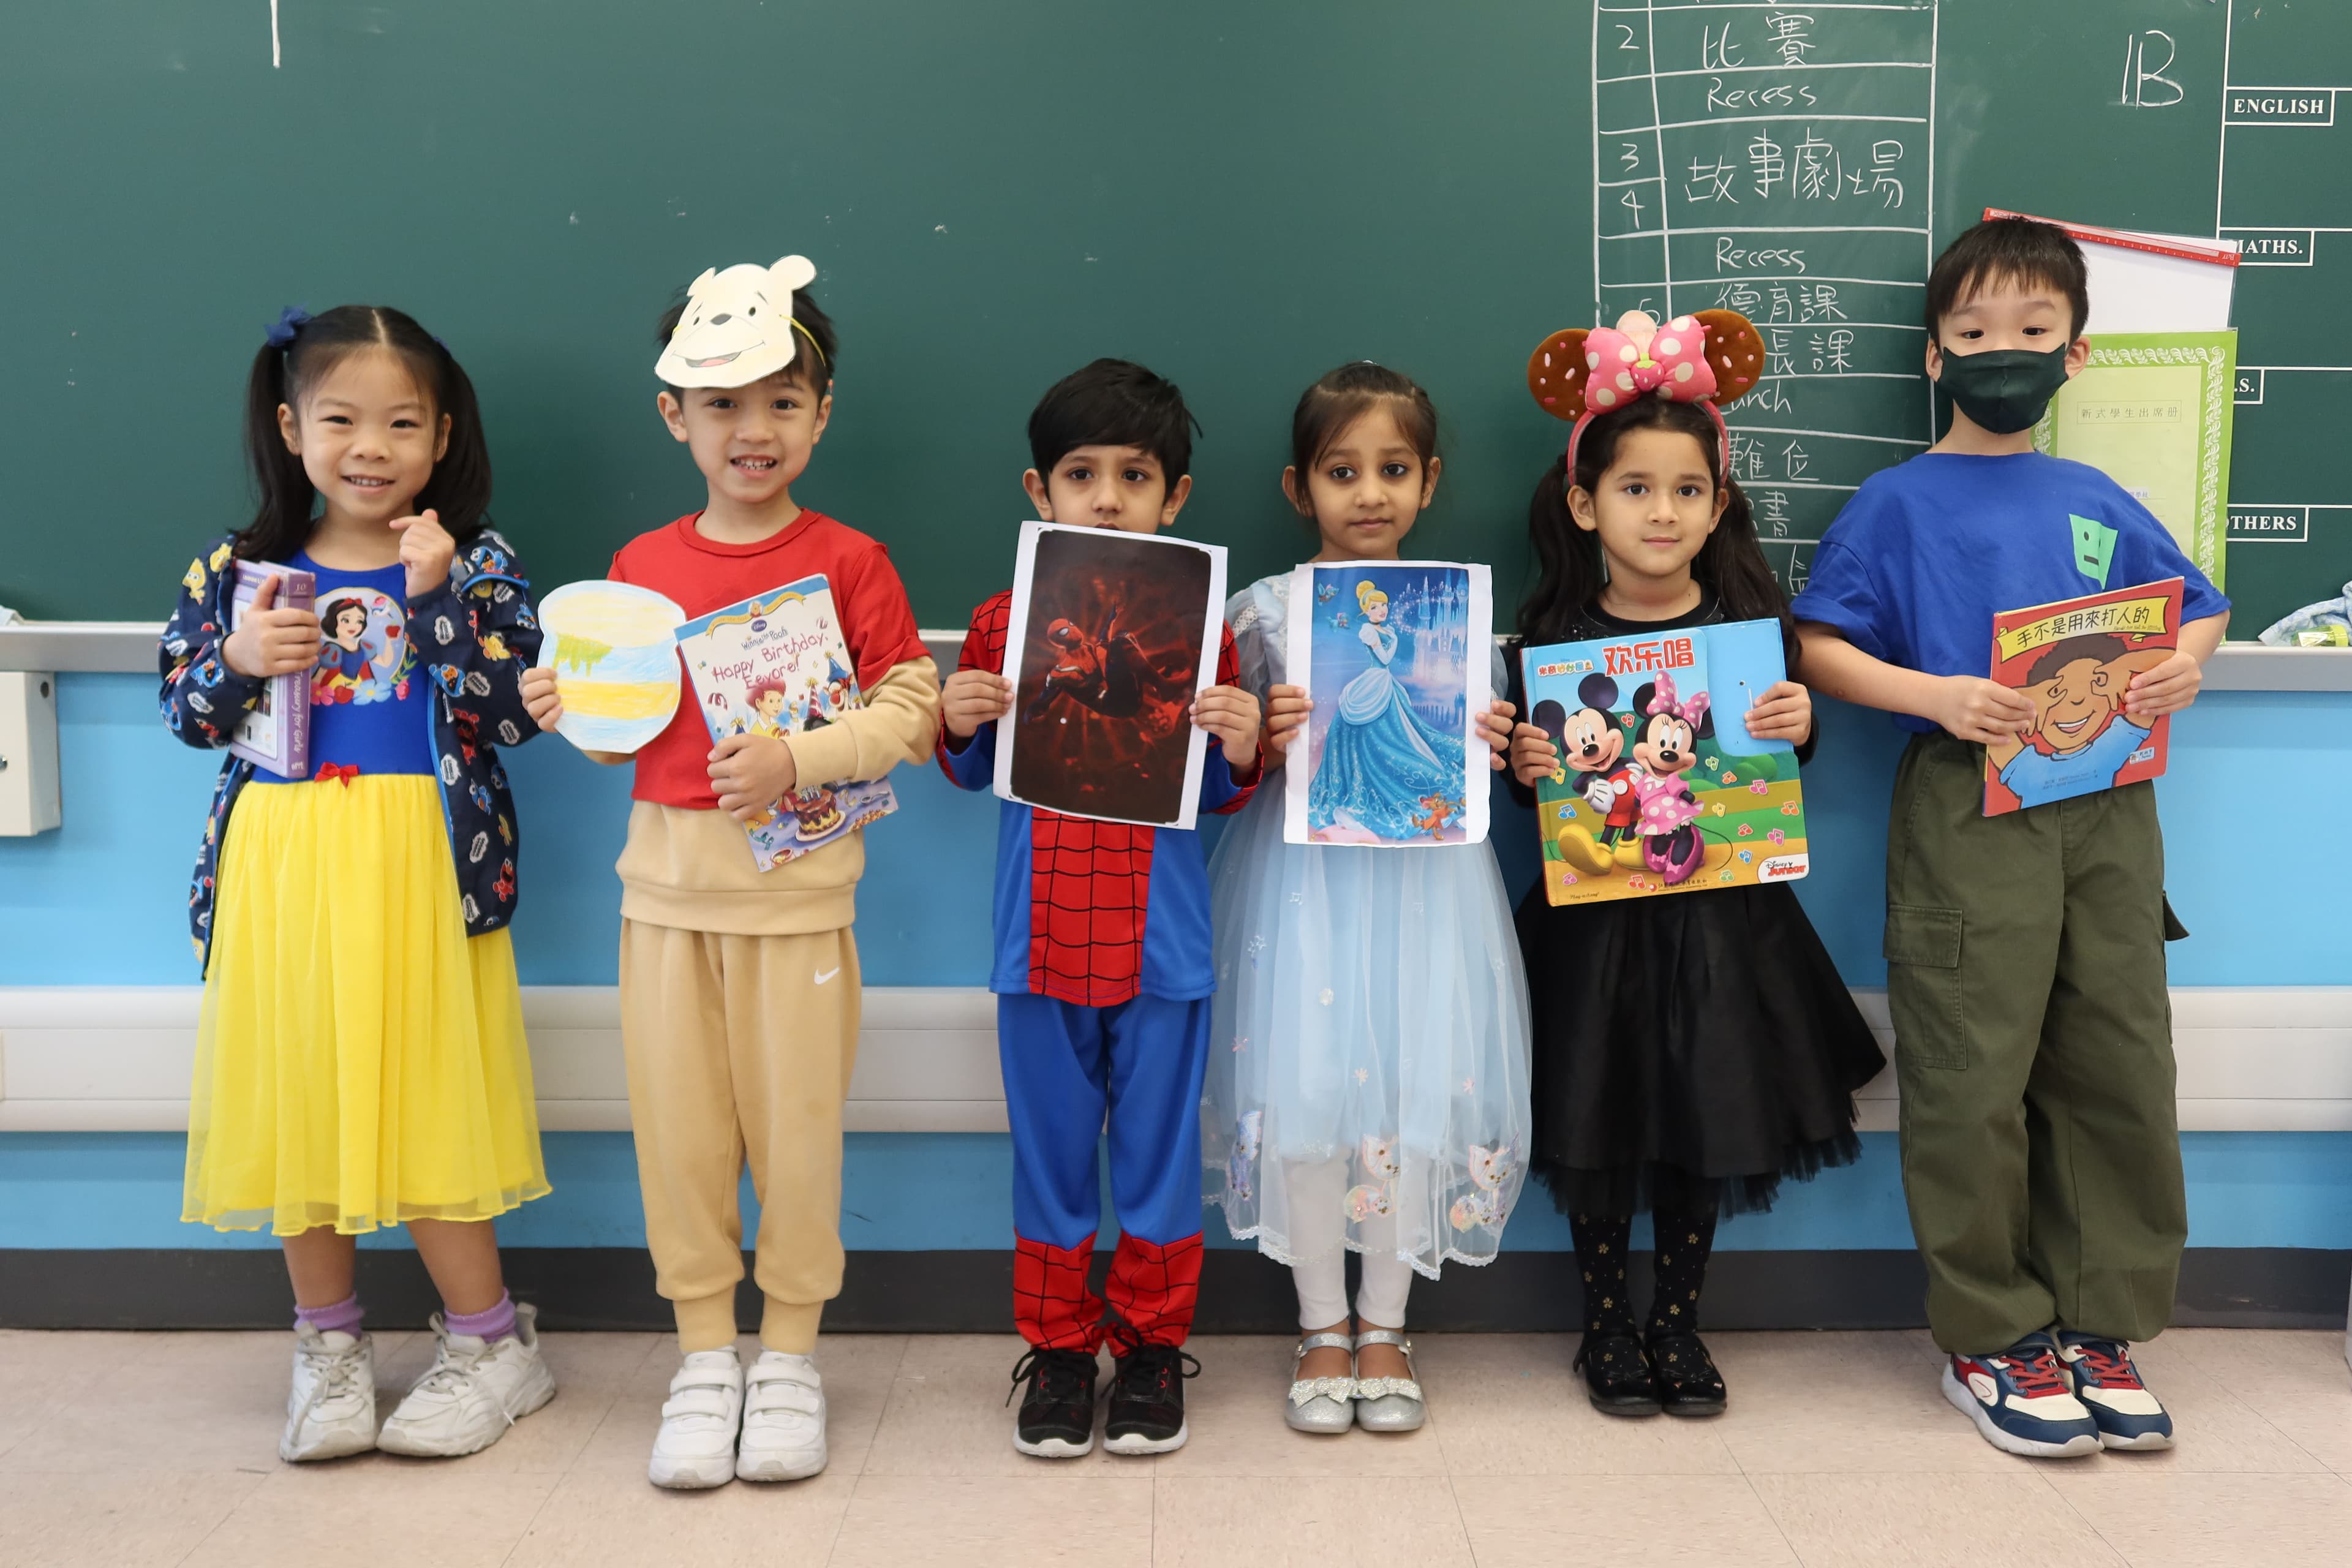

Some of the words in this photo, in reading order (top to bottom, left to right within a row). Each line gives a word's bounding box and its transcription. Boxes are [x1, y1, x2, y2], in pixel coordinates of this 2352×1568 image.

[1615, 24, 1640, 50] 2
[1702, 11, 1816, 69] 比賽
[1707, 77, 1817, 112] Recess
[2233, 99, 2324, 115] ENGLISH
[1619, 143, 1639, 172] 3
[1685, 127, 1904, 208] 故事劇場
[1621, 190, 1645, 230] 4
[1716, 237, 1806, 273] Recess
[1720, 380, 1792, 415] unch
[2016, 606, 2150, 648] 手不是用來打人的
[712, 659, 754, 683] Happy
[1602, 637, 1695, 677] 欢乐唱
[292, 712, 304, 728] for
